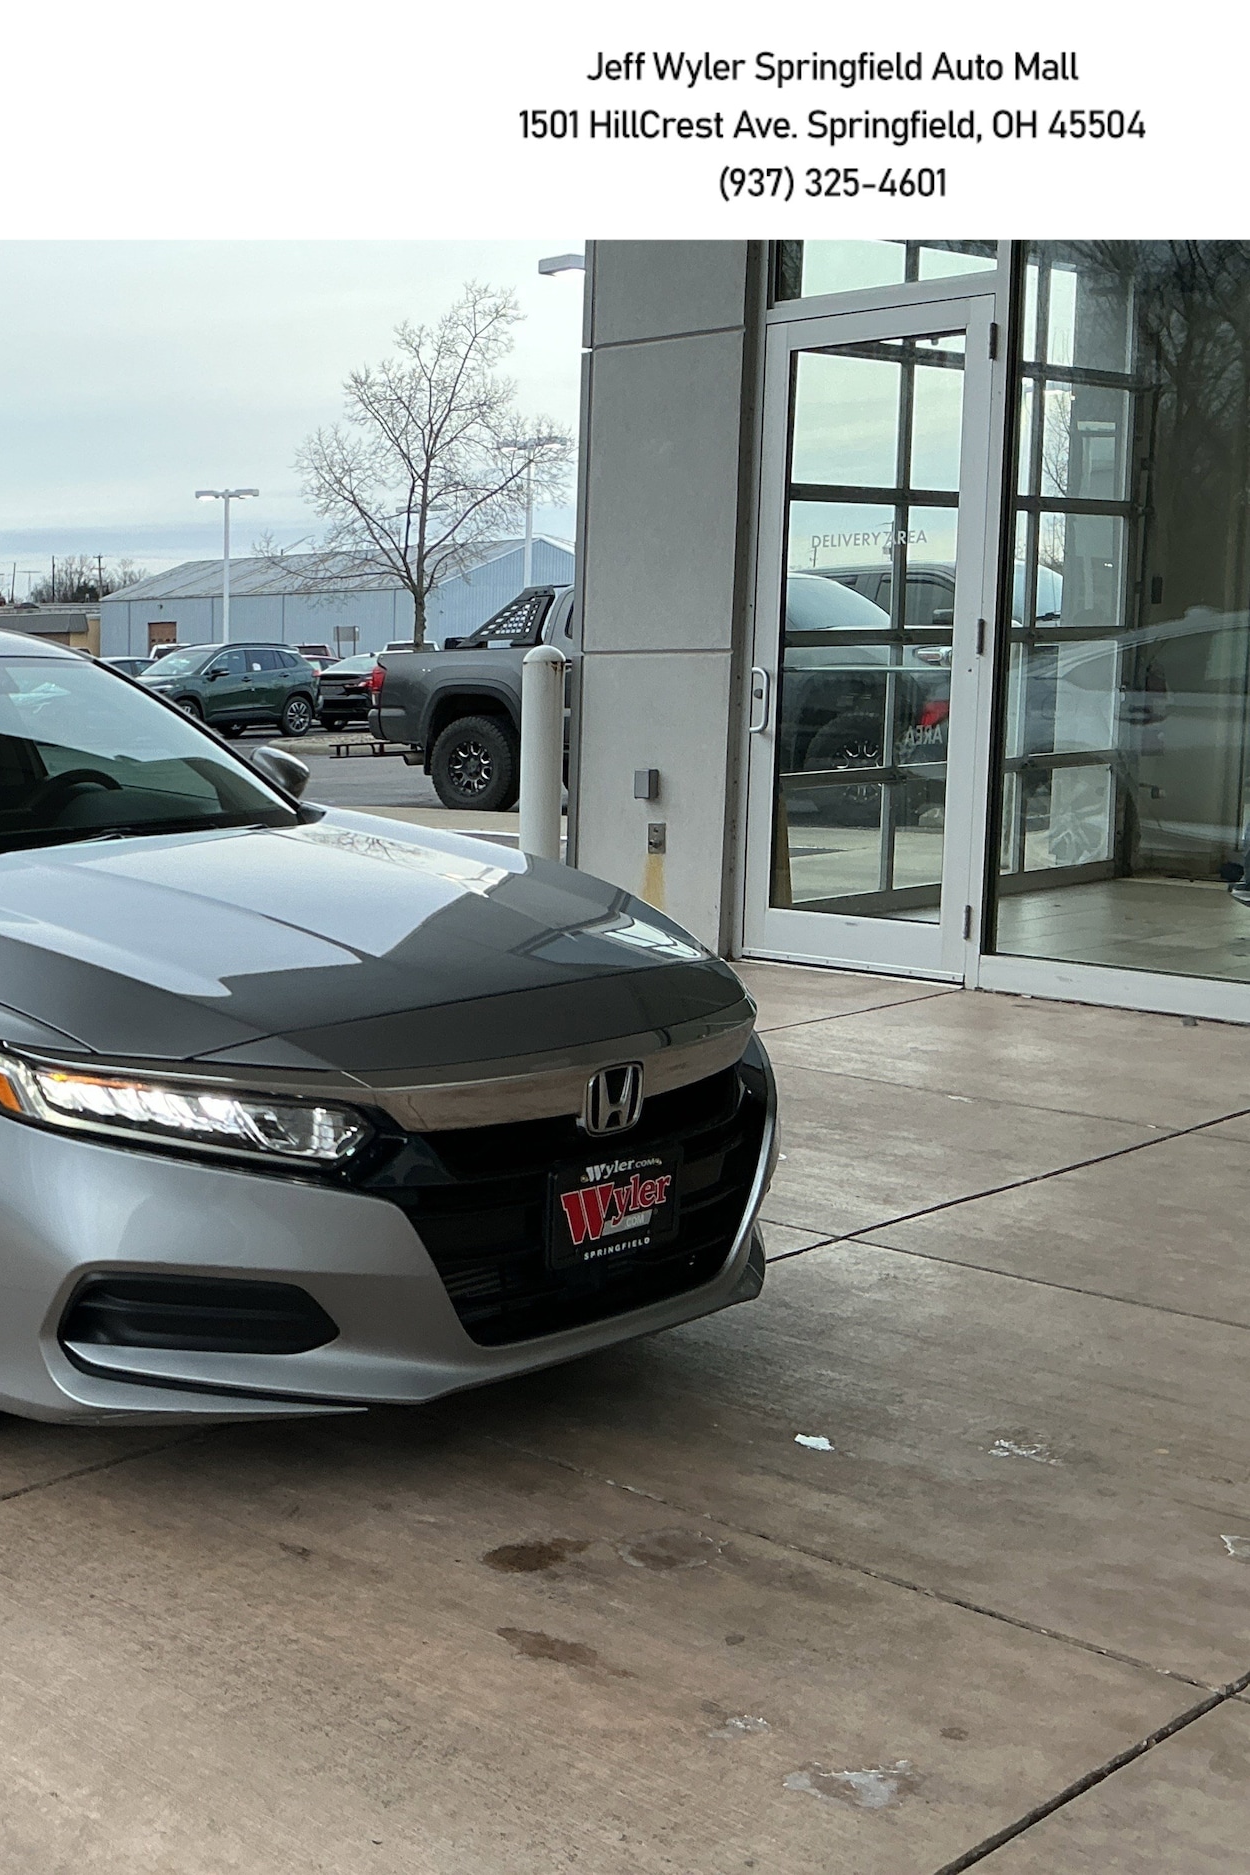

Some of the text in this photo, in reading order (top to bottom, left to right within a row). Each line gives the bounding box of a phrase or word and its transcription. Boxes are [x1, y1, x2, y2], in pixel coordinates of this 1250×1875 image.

[811, 529, 928, 549] DELIVERY AREA
[560, 1173, 672, 1246] Wyler
[583, 1236, 651, 1261] SPRINGFIELD
